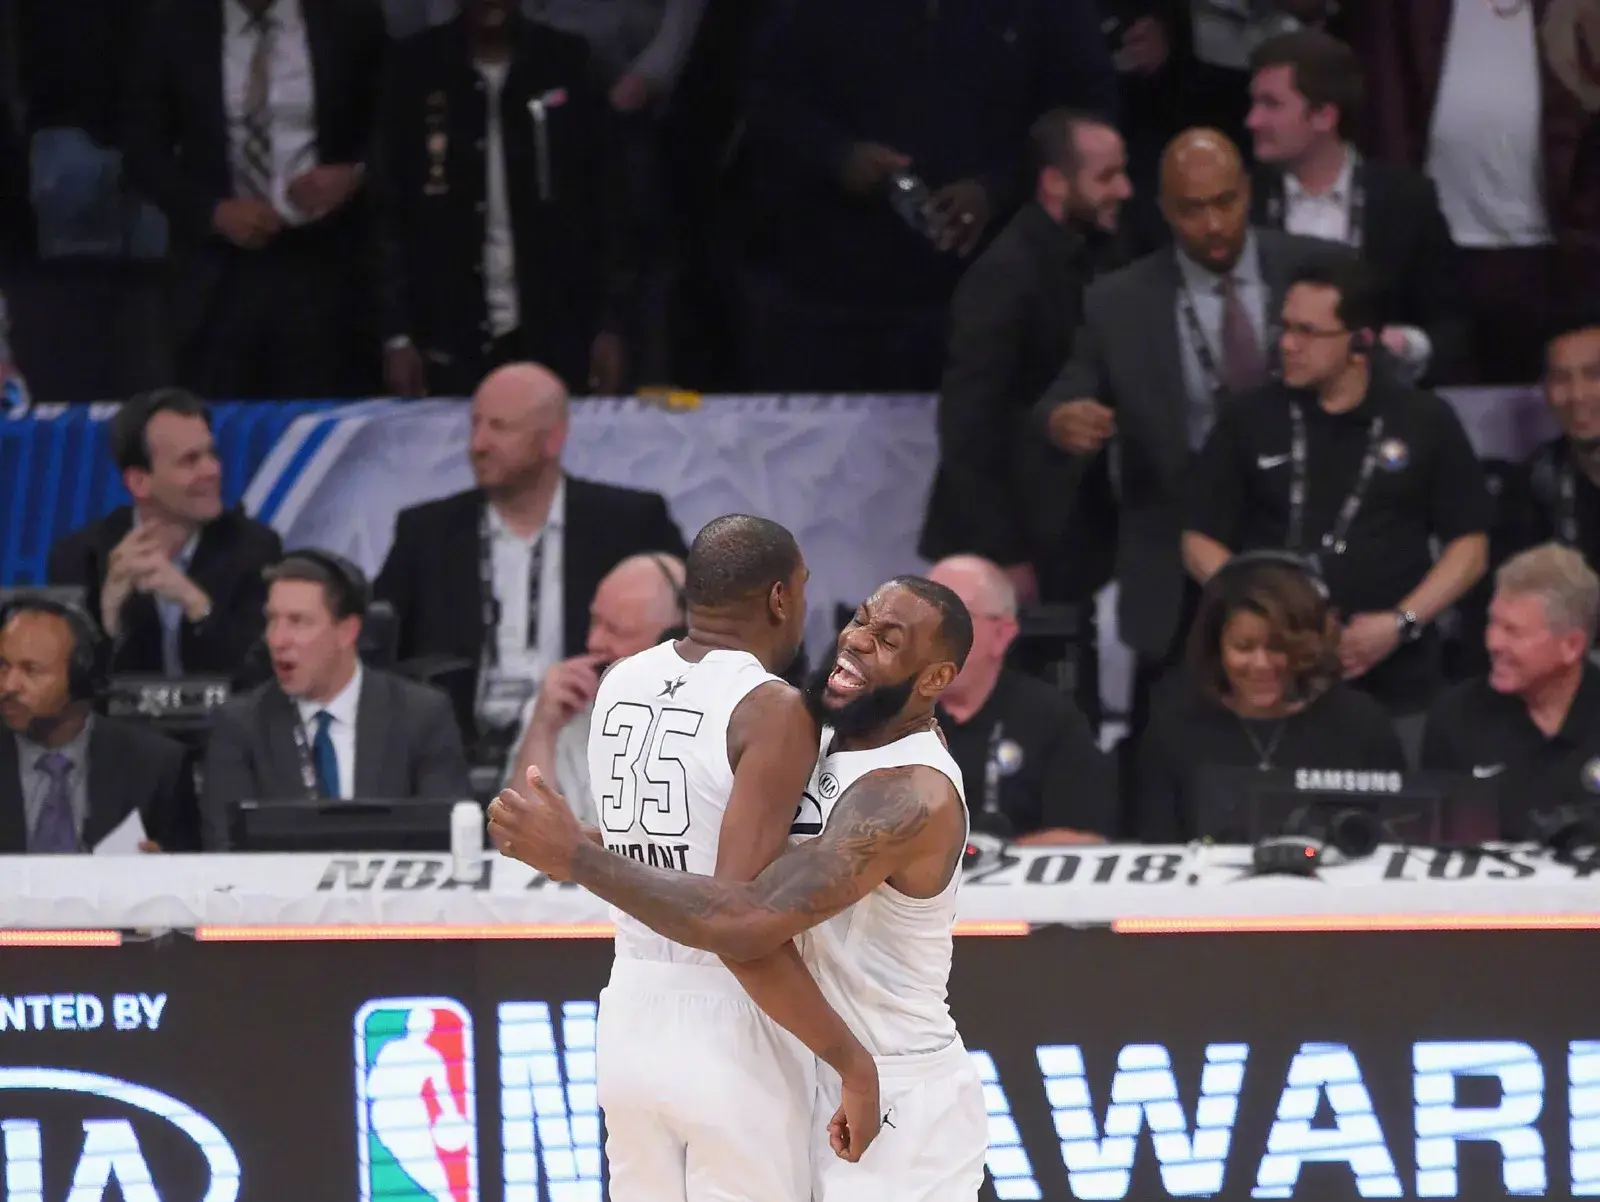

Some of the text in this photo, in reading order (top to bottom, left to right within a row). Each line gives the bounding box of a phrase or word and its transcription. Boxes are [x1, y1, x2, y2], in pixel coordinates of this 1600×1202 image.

[602, 701, 704, 837] 35
[820, 775, 836, 797] KIA
[1295, 767, 1402, 792] SAMSUNG
[112, 993, 168, 1031] BY
[968, 1040, 1600, 1200] WAR
